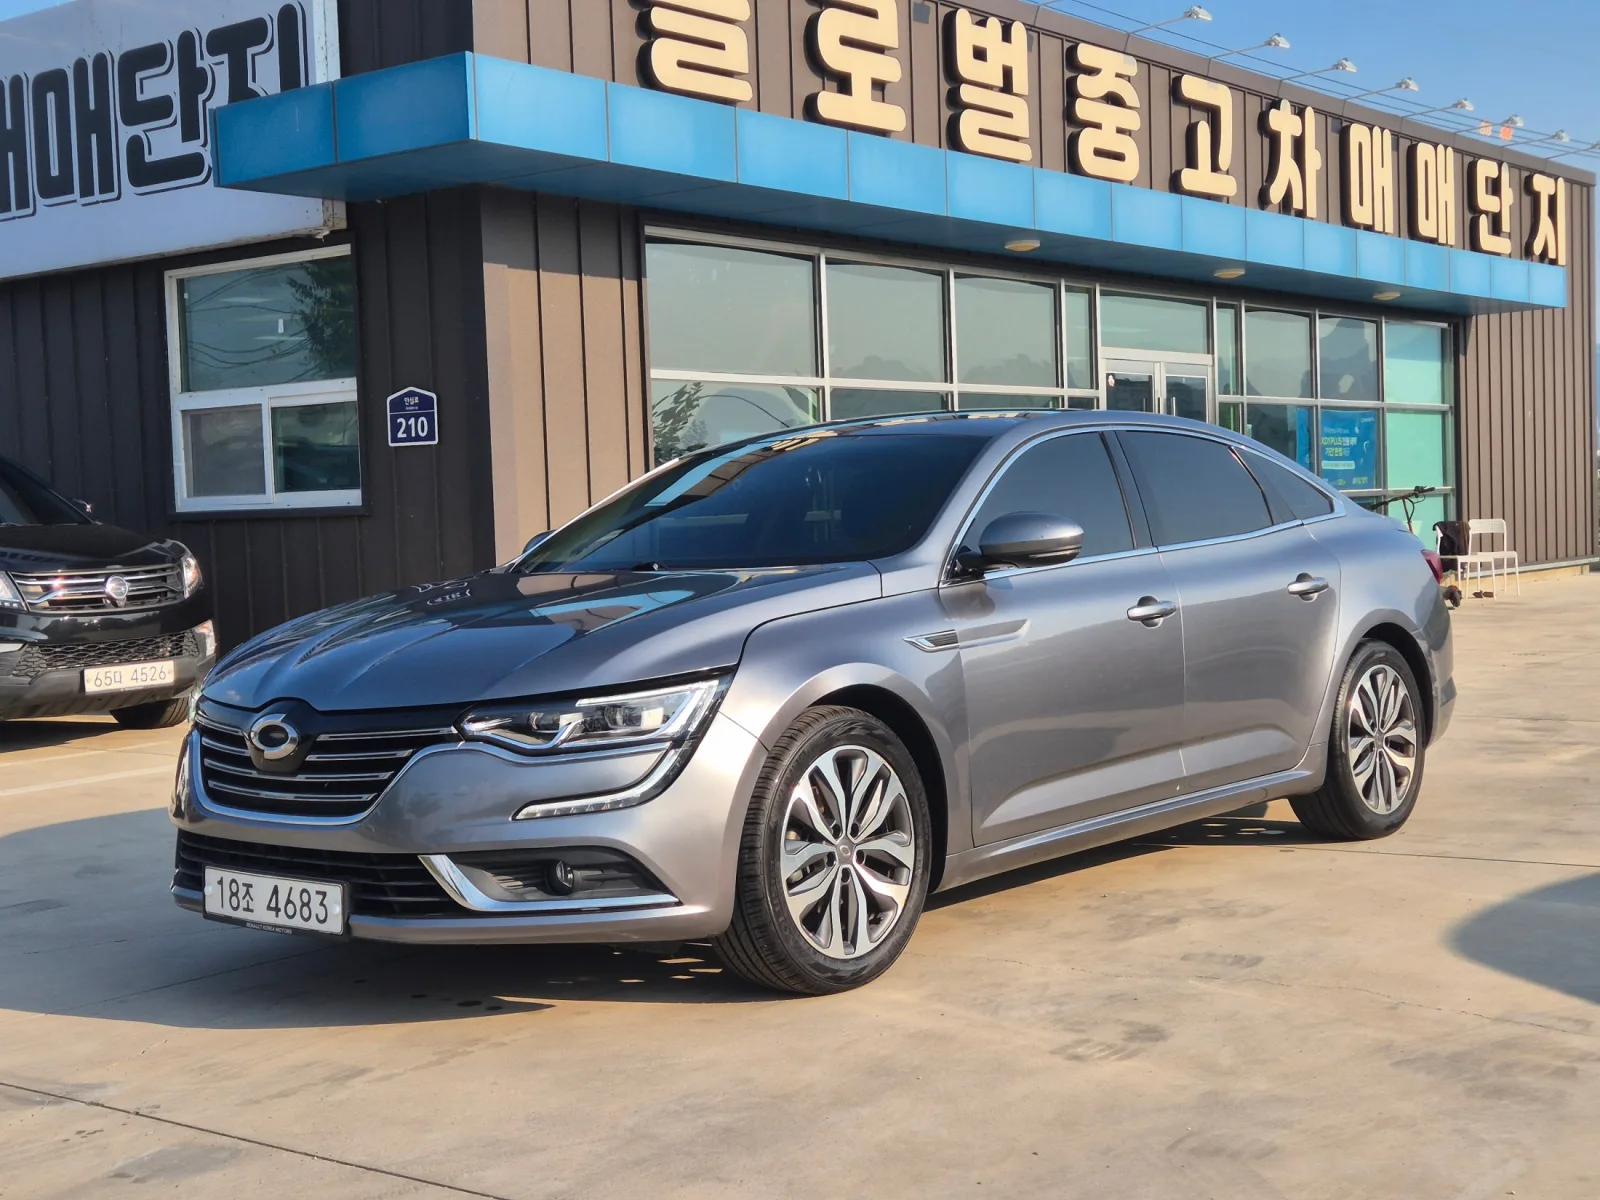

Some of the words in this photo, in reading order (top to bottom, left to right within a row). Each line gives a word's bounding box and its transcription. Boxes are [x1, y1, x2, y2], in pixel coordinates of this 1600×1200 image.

[396, 416, 428, 438] 210
[131, 665, 167, 684] 4526
[217, 876, 254, 913] 18조
[266, 884, 328, 924] 4683
